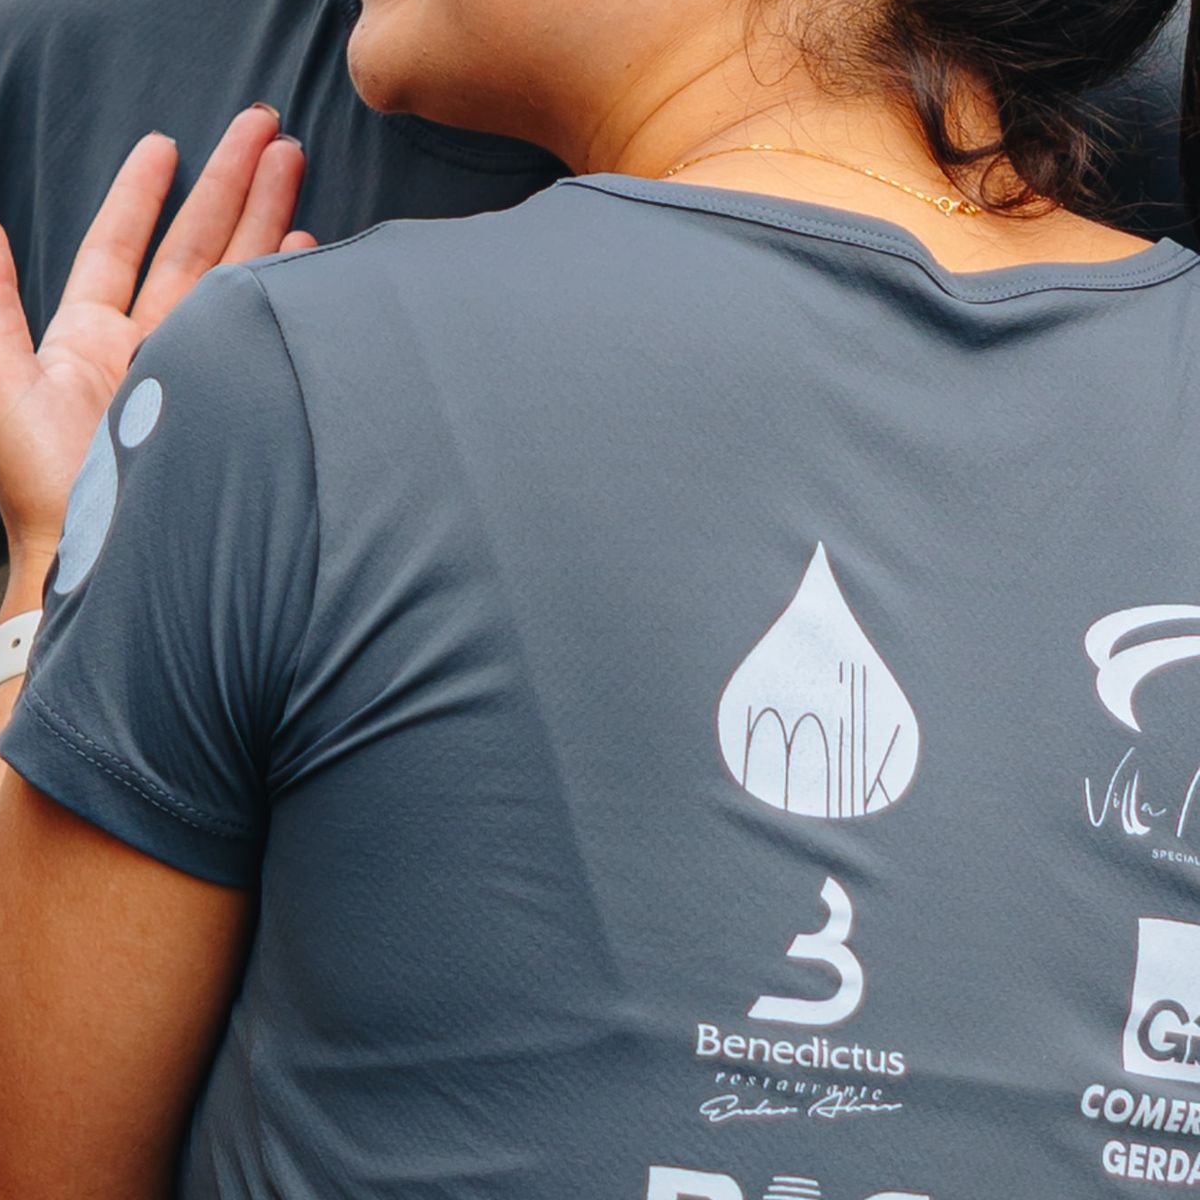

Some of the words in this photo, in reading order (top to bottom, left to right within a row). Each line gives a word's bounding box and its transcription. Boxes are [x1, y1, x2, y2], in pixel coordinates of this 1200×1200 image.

[742, 661, 901, 818] milk
[1084, 746, 1167, 835] Villa
[1151, 847, 1200, 867] SPECIAL
[695, 1023, 905, 1076] Benedictus
[1080, 1084, 1200, 1136] COMER
